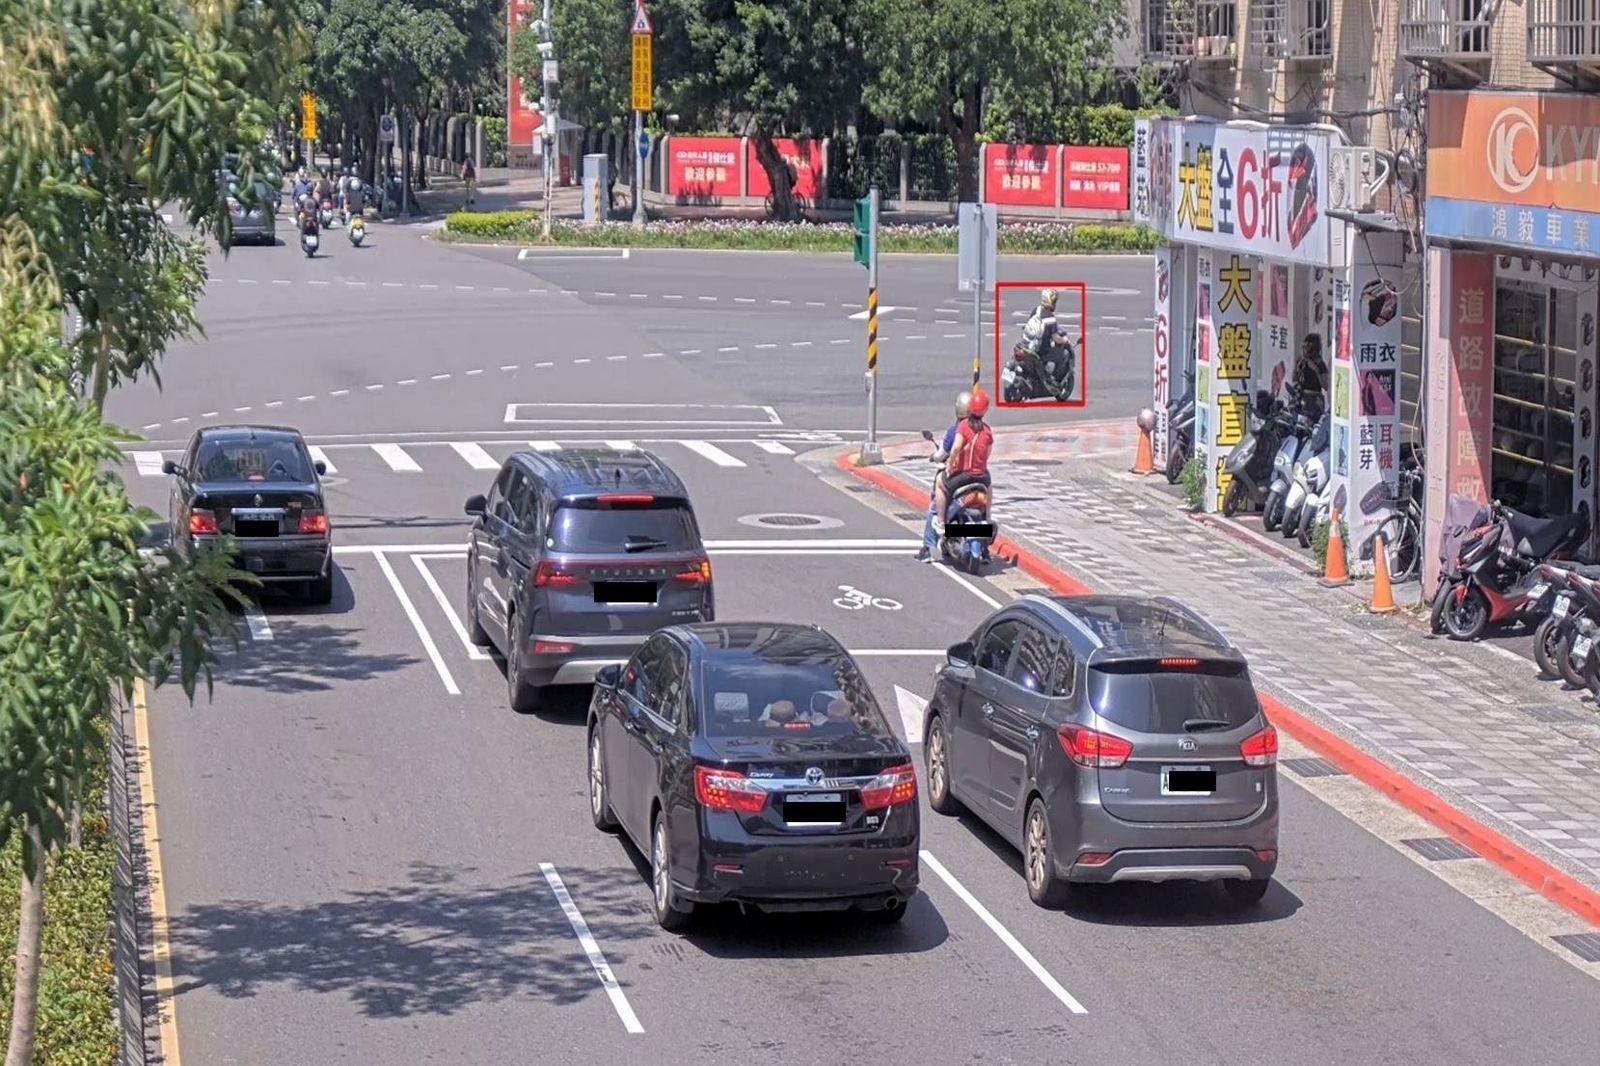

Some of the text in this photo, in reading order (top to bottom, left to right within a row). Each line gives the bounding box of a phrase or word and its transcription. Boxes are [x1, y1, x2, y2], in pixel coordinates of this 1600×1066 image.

[1492, 207, 1590, 249] 鴻毅車業
[1270, 325, 1288, 350] 手套
[1360, 342, 1396, 363] 雨衣
[1154, 316, 1169, 404] 6折
[1360, 424, 1373, 470] 藍芽
[1379, 424, 1393, 470] 耳機
